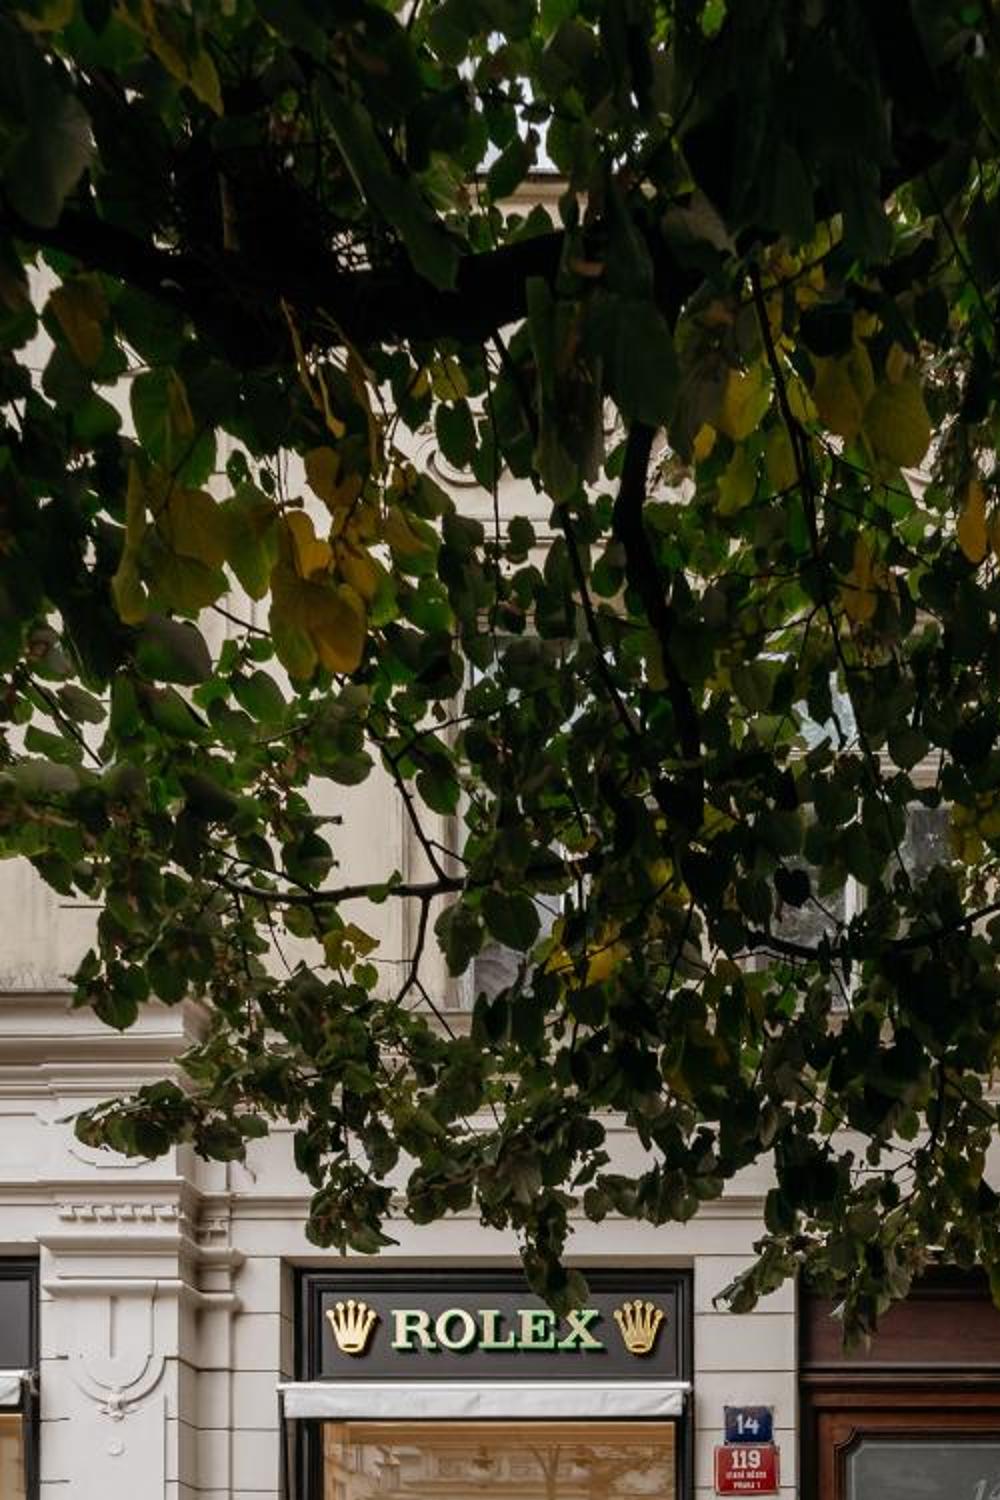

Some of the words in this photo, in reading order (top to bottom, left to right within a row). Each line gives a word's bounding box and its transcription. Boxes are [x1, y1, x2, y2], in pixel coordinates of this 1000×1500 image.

[391, 1308, 603, 1349] ROLEX
[736, 1413, 760, 1435] 14
[731, 1450, 761, 1469] 119
